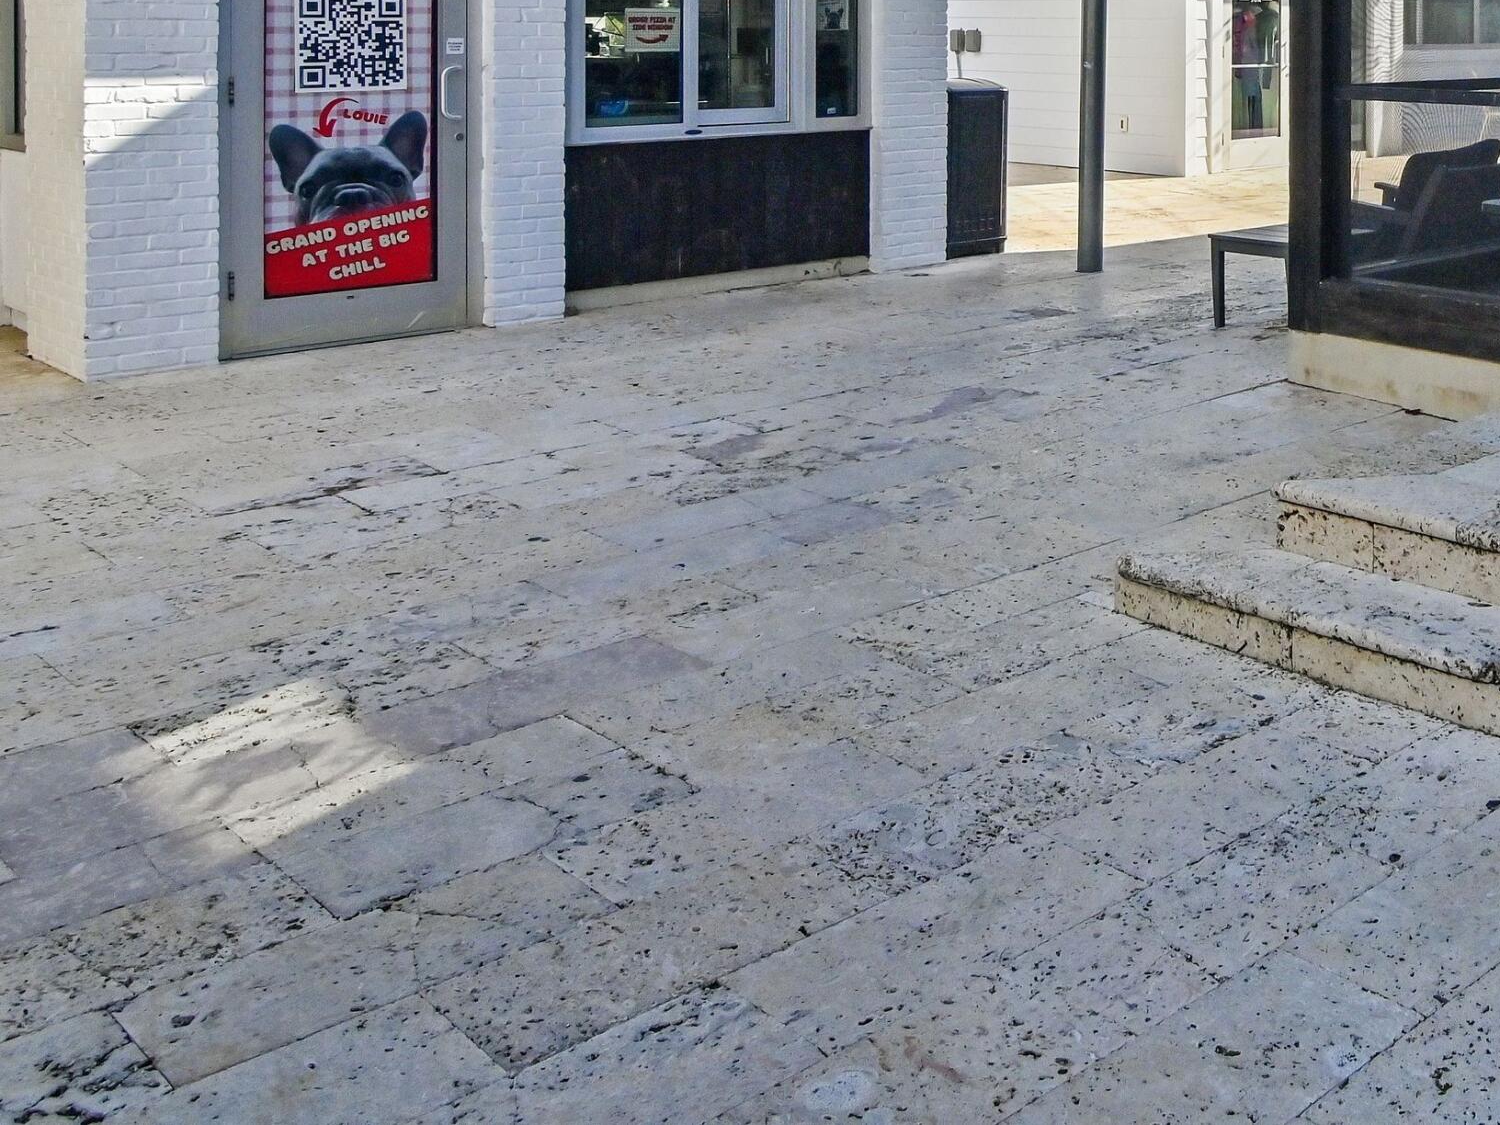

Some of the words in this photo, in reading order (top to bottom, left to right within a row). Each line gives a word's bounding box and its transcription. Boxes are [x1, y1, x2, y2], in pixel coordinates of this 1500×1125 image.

[343, 108, 388, 125] LOUIE
[266, 227, 337, 254] GRAND
[343, 205, 429, 236] OPENING
[302, 249, 328, 267] AT
[335, 238, 373, 258] THE
[378, 230, 410, 248] BIG
[329, 257, 386, 280] CHILL
